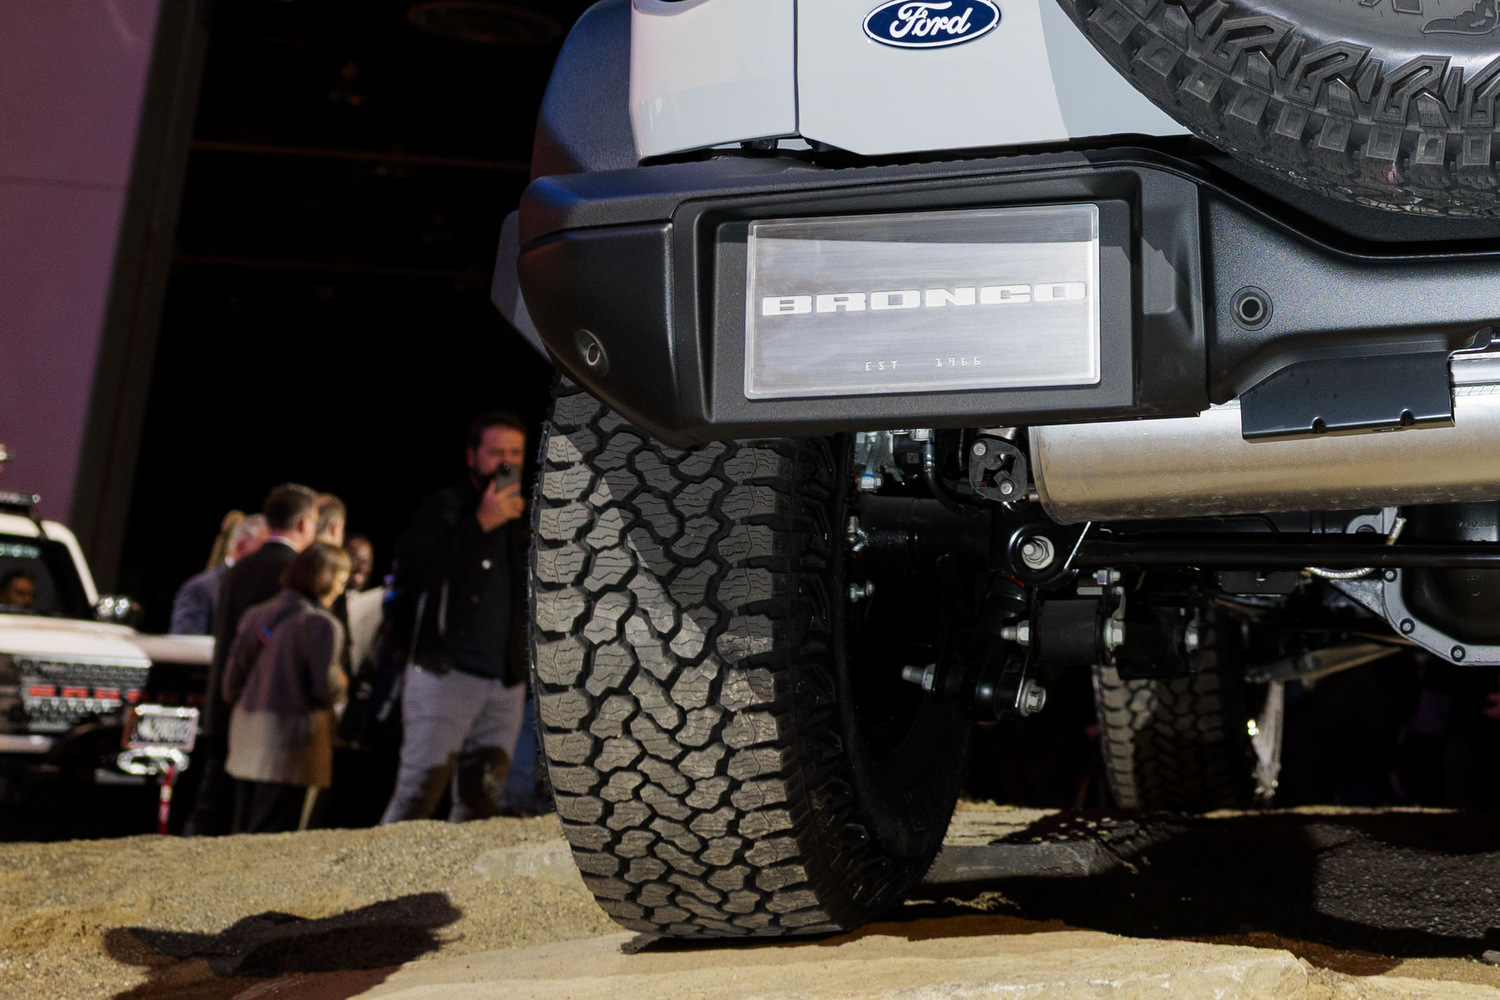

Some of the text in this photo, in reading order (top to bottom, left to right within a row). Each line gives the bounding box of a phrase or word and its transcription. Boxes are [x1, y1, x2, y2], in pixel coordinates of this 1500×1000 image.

[889, 1, 974, 39] Ford
[761, 281, 1087, 316] BRONCO
[865, 356, 981, 372] EST 1966
